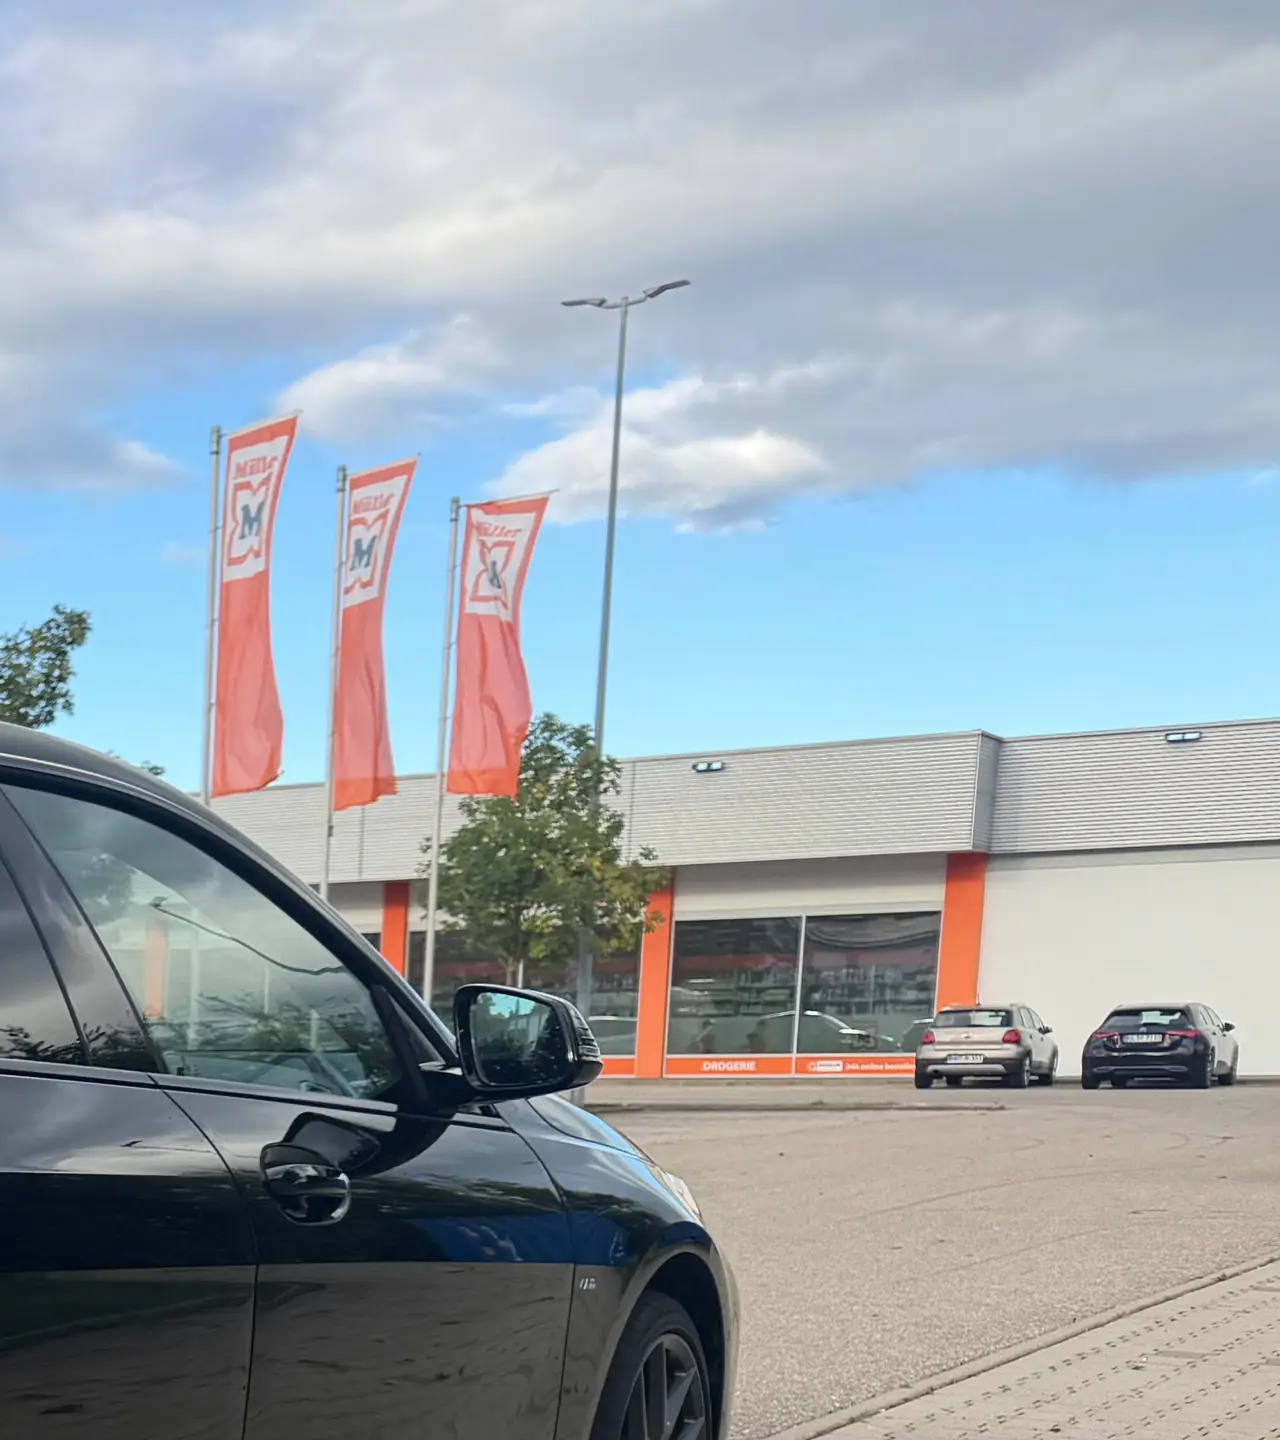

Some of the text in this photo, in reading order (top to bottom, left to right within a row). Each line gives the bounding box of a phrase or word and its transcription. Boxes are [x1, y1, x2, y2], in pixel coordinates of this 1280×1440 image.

[239, 501, 265, 540] M
[350, 535, 377, 571] M
[702, 1061, 756, 1071] DROGERIE
